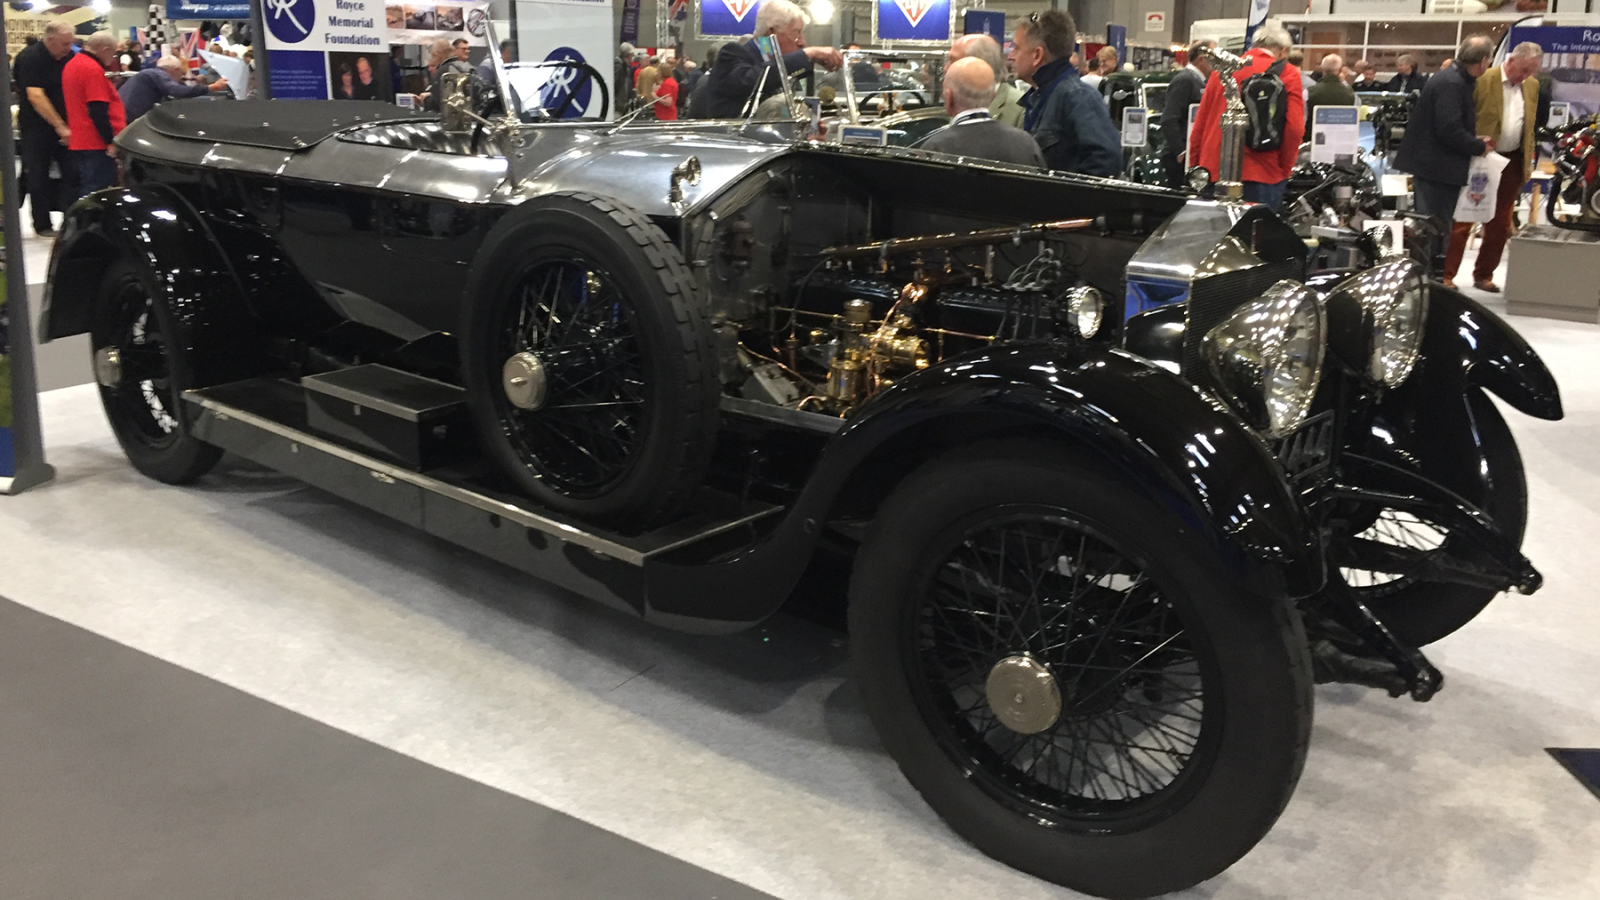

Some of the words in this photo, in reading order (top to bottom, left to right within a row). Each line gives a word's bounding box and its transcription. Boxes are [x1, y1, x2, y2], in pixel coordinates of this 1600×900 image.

[336, 0, 365, 12] Royce
[328, 16, 374, 28] Memorial
[325, 33, 380, 45] Foundation
[1552, 42, 1568, 51] The
